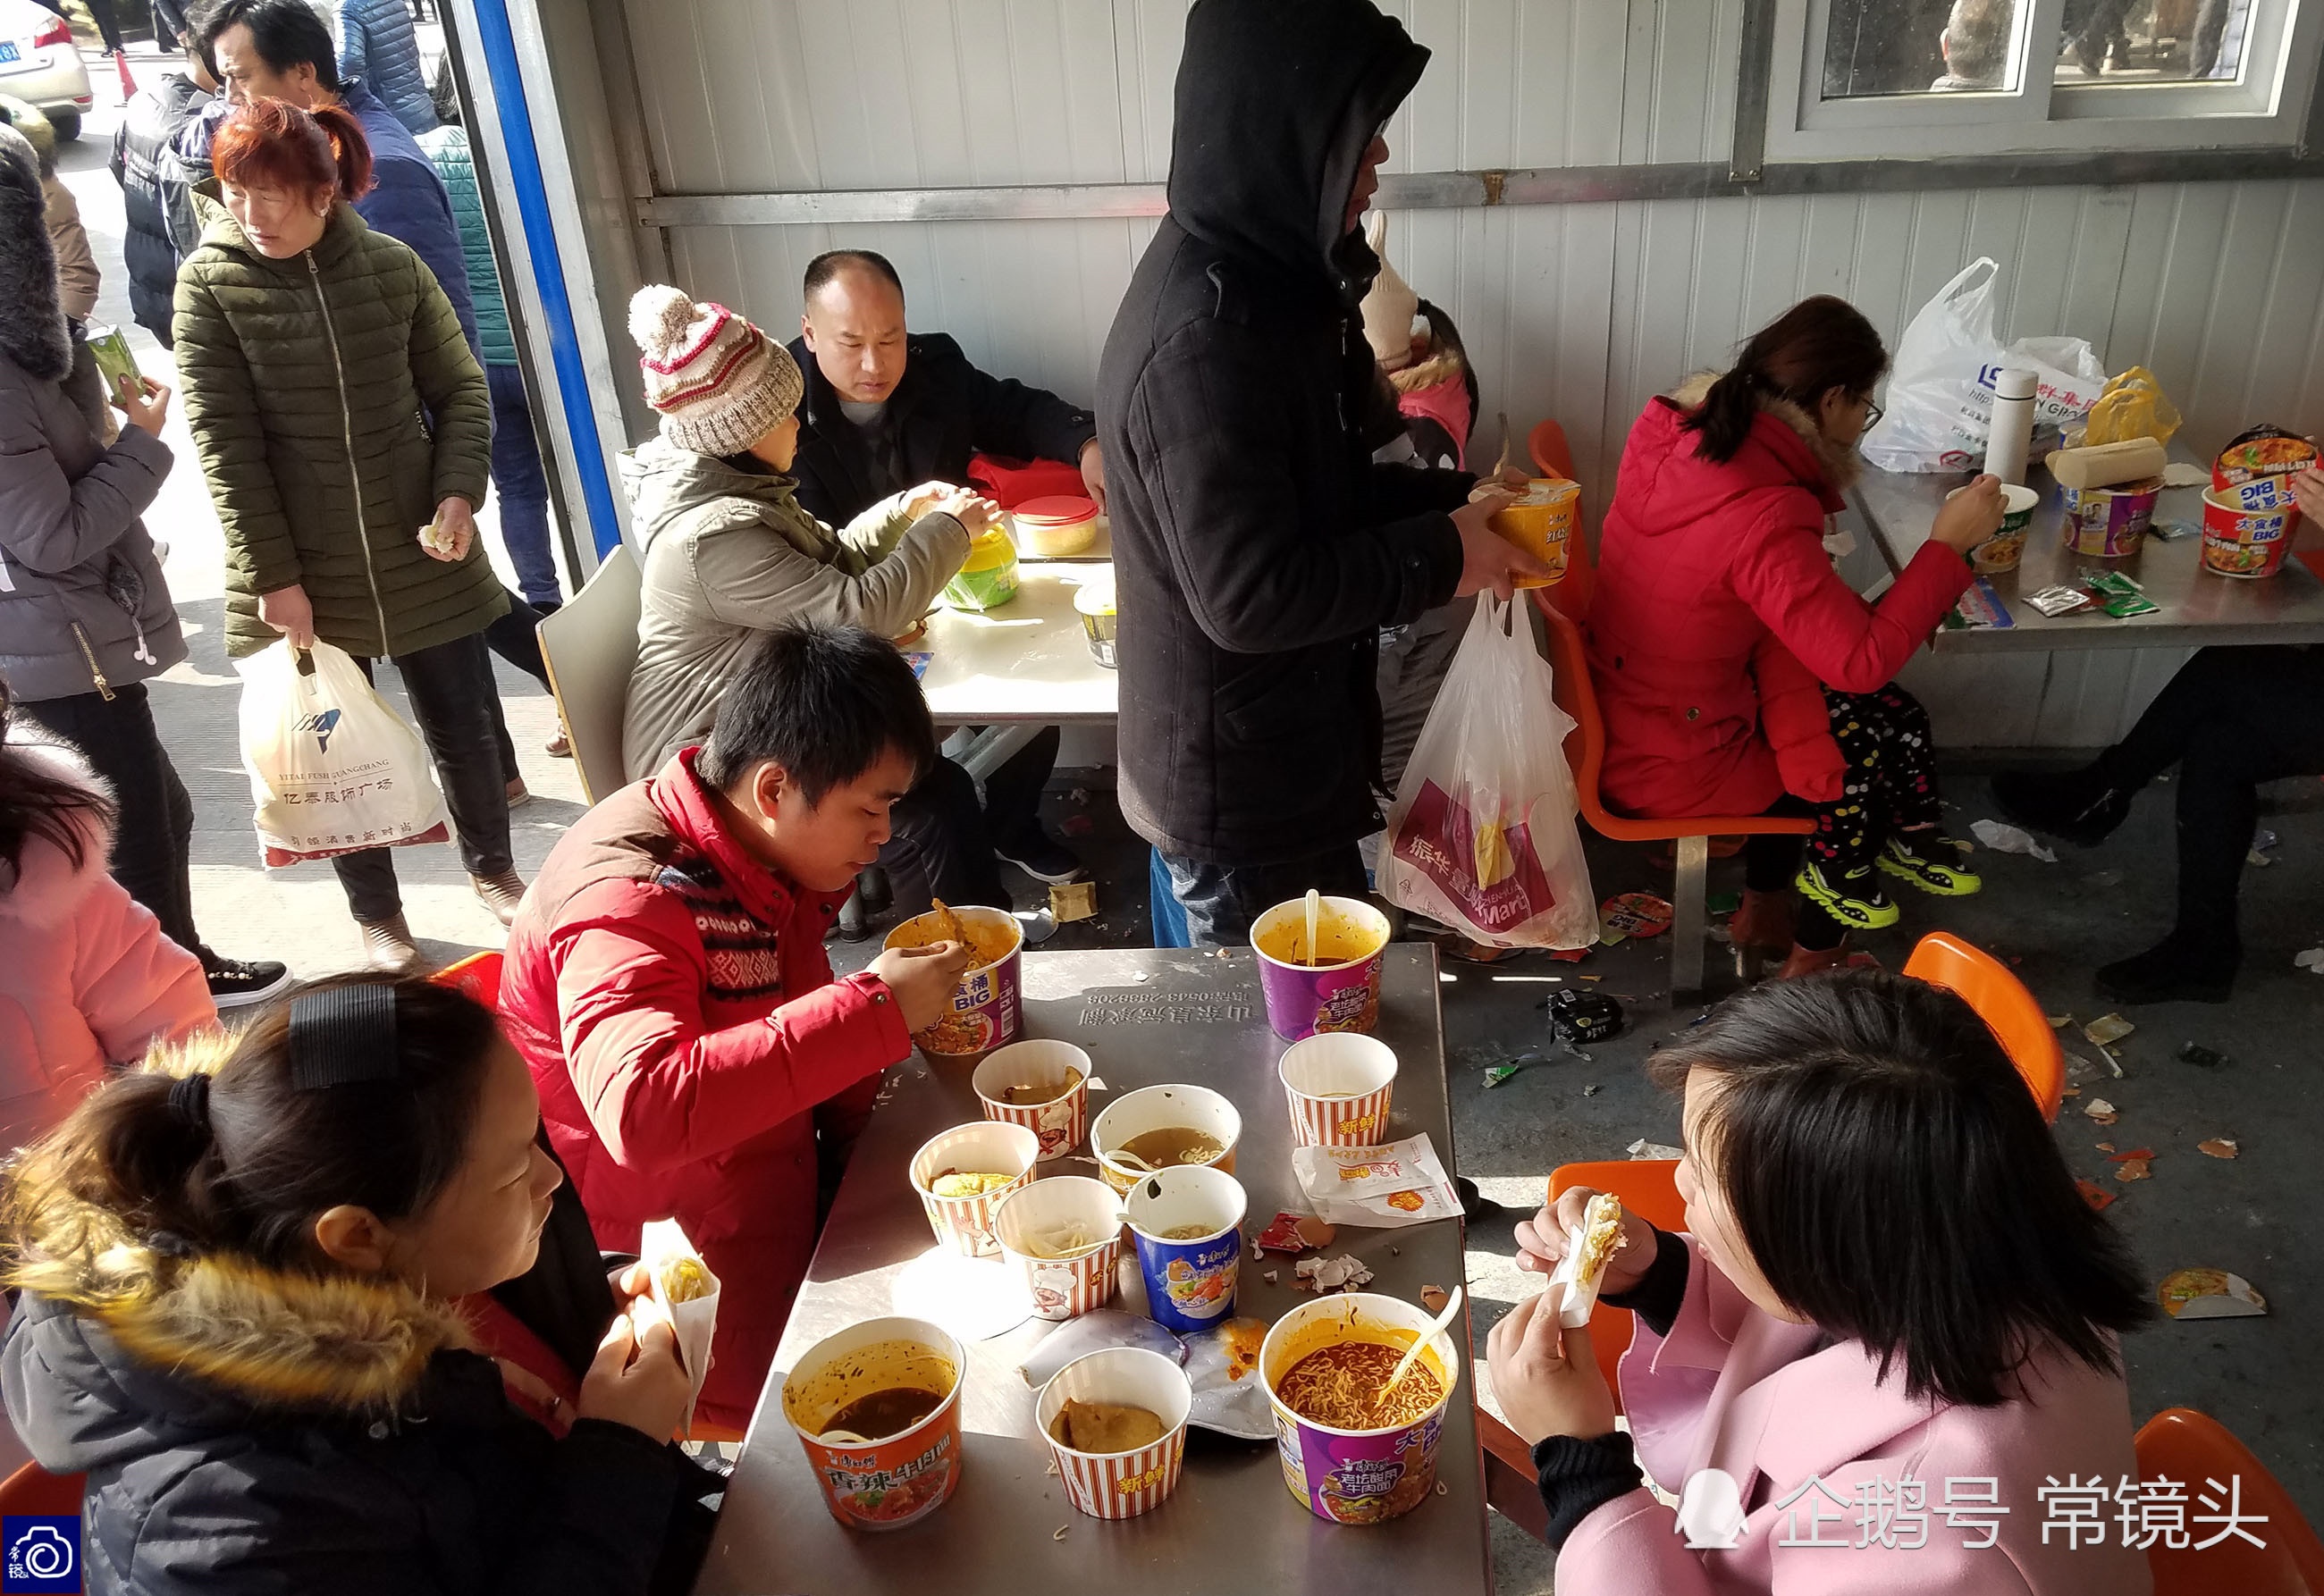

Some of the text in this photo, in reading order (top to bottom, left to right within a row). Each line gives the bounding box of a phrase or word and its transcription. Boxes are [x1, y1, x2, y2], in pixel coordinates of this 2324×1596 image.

[2240, 480, 2275, 500] BIG
[2236, 515, 2284, 530] 大食桶
[2252, 528, 2280, 542] BIG
[283, 777, 393, 805] 亿泰服饰广场
[955, 990, 990, 1011] BIG
[1339, 1113, 1377, 1135] 新鲜
[1117, 1464, 1166, 1495] 新鲜
[1346, 1480, 1392, 1494] 牛肉面
